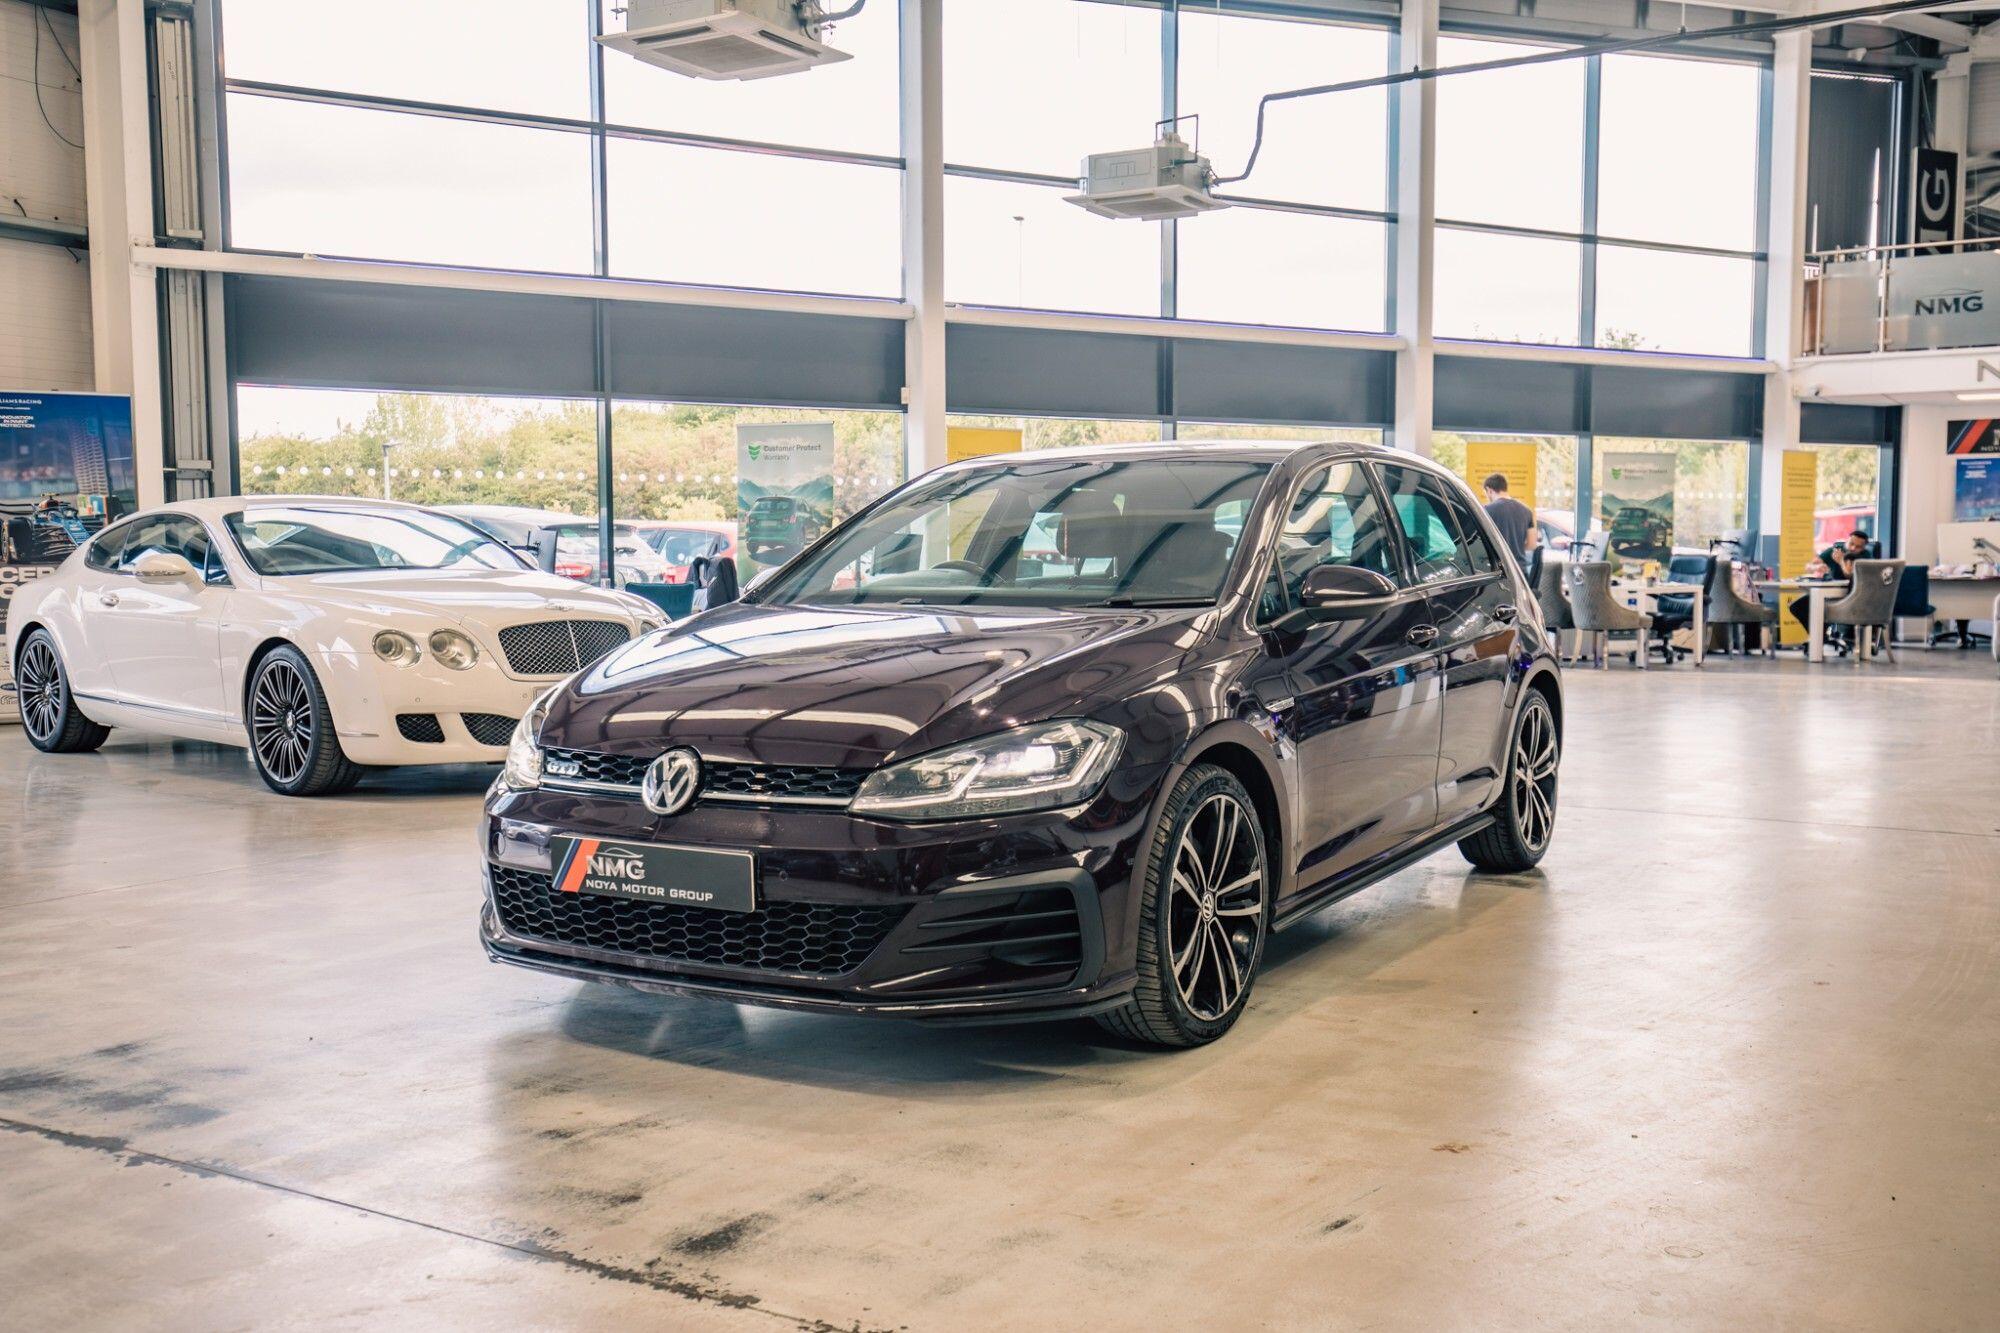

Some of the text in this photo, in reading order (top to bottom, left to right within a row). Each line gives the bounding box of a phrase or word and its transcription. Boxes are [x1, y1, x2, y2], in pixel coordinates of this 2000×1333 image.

[1915, 296, 1984, 316] NMG
[586, 855, 646, 880] NMG
[585, 879, 714, 901] NOYA MOTOR GROUP
